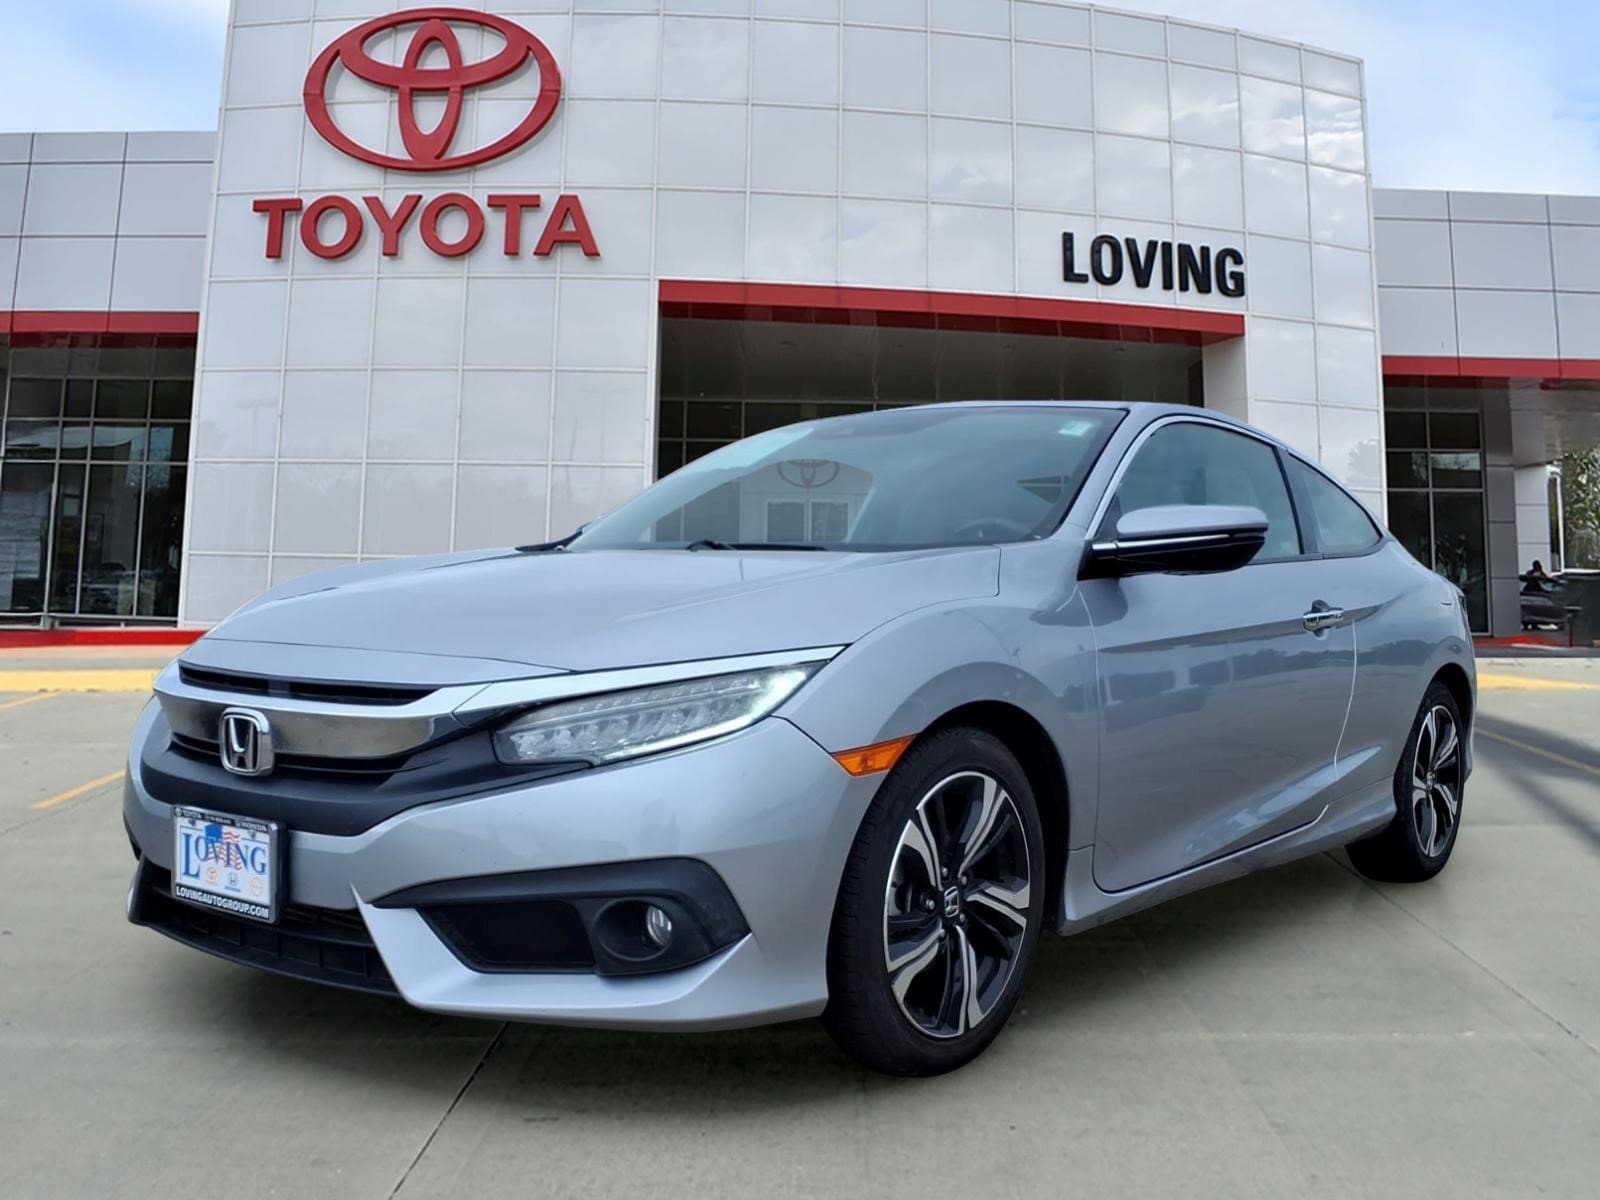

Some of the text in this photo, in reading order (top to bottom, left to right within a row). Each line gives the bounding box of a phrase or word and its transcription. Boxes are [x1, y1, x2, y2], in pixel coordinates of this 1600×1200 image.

[253, 192, 600, 259] TOYOTA
[1062, 231, 1246, 298] LOVING
[182, 832, 267, 880] LOVING
[176, 886, 269, 919] LOVINGAUTOGROUP.COM
